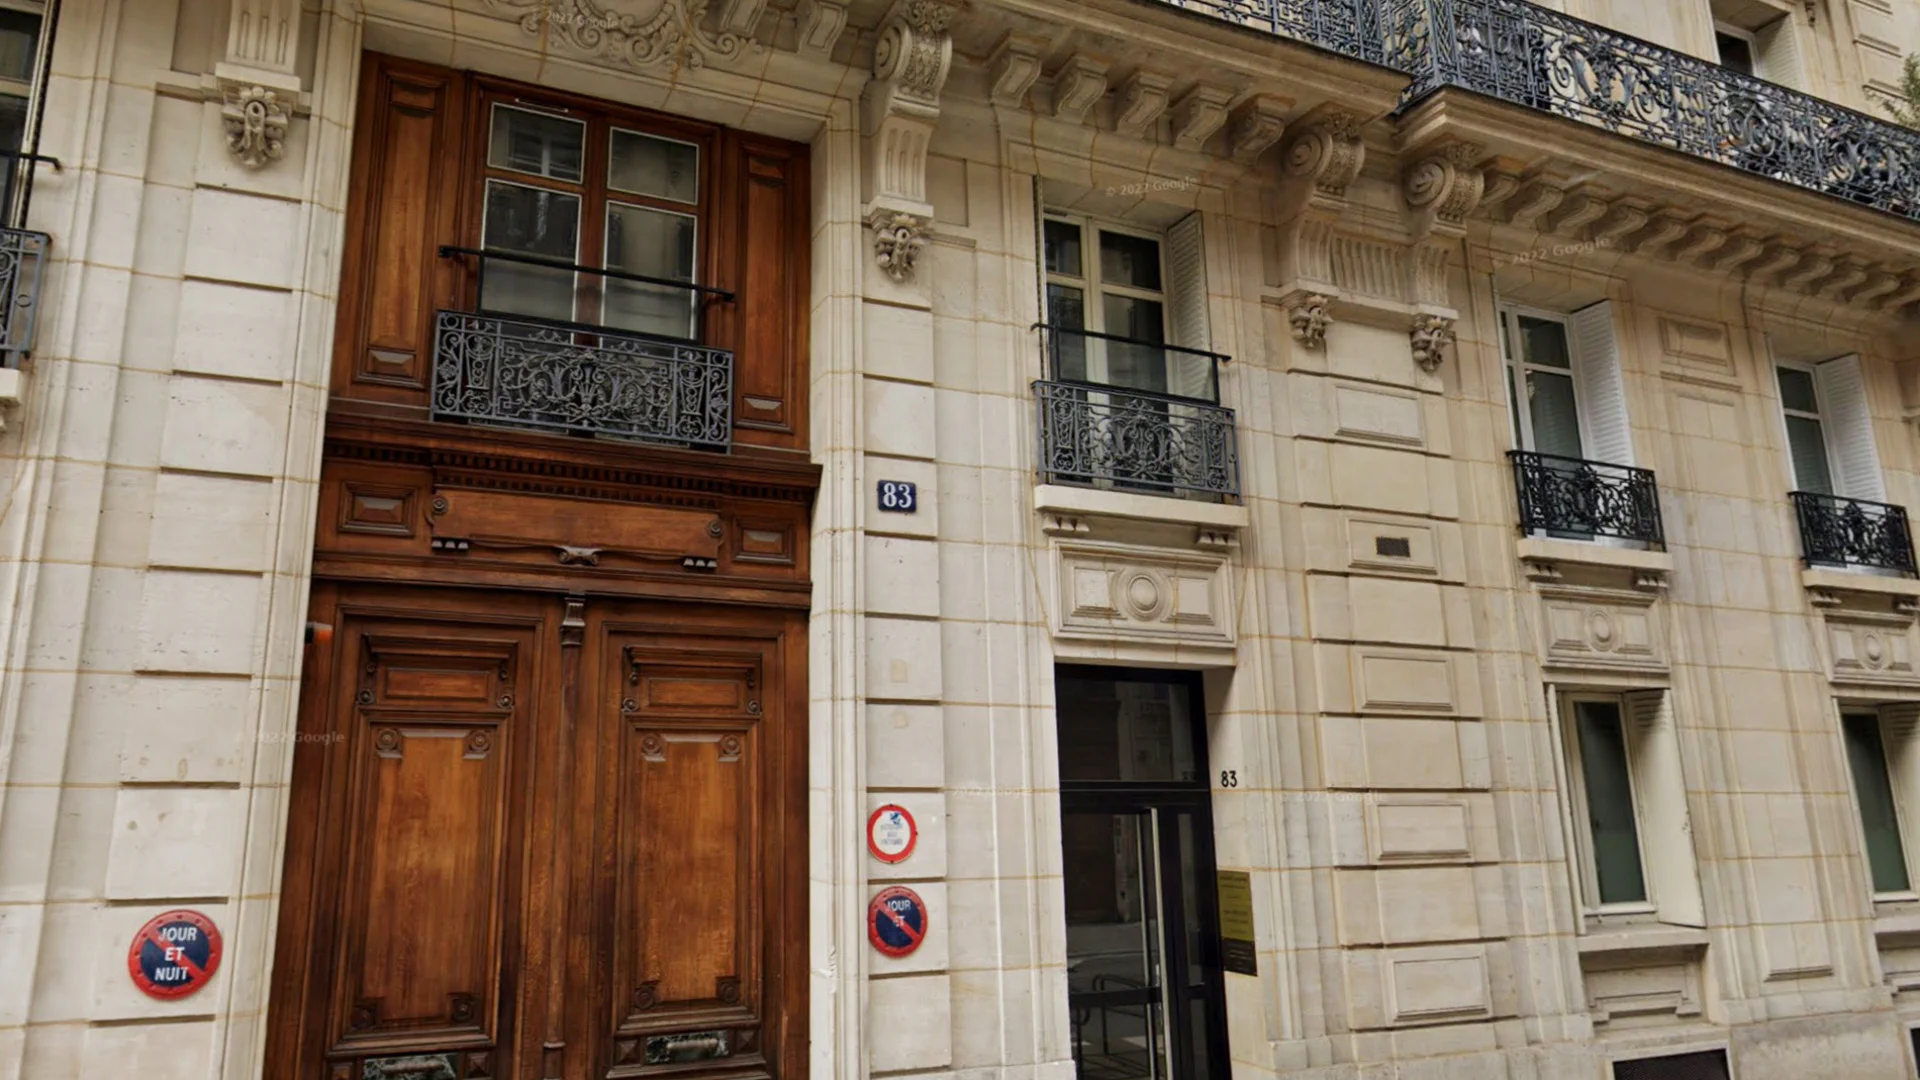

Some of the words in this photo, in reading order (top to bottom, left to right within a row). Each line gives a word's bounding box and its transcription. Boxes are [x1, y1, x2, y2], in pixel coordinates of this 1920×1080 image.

[883, 482, 912, 508] 83
[1221, 770, 1238, 787] 83
[886, 899, 911, 911] JOUR
[158, 927, 197, 941] JOUR
[164, 946, 185, 961] ET
[154, 967, 189, 981] NUIT
